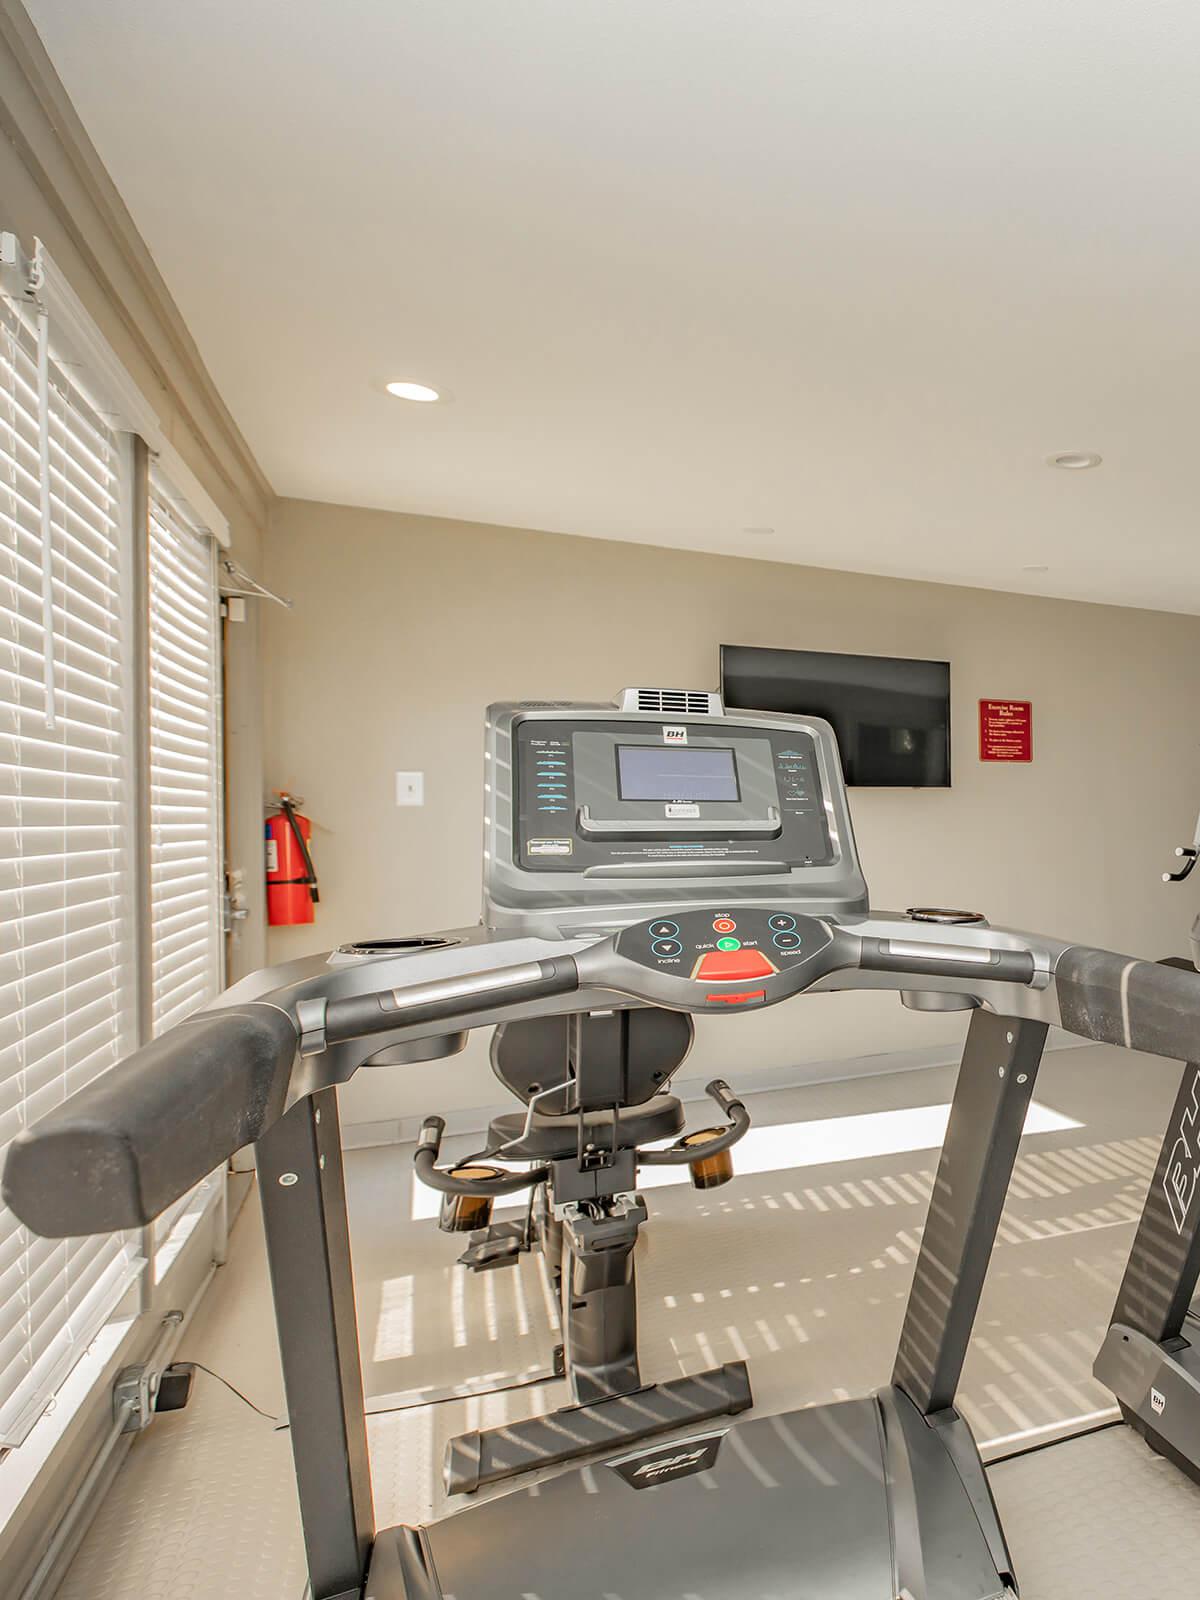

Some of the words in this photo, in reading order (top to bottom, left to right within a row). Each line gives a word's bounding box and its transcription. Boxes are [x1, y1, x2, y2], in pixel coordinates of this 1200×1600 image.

[666, 730, 685, 738] BH
[695, 942, 715, 951] quick
[780, 949, 802, 957] speed
[657, 957, 681, 965] incline
